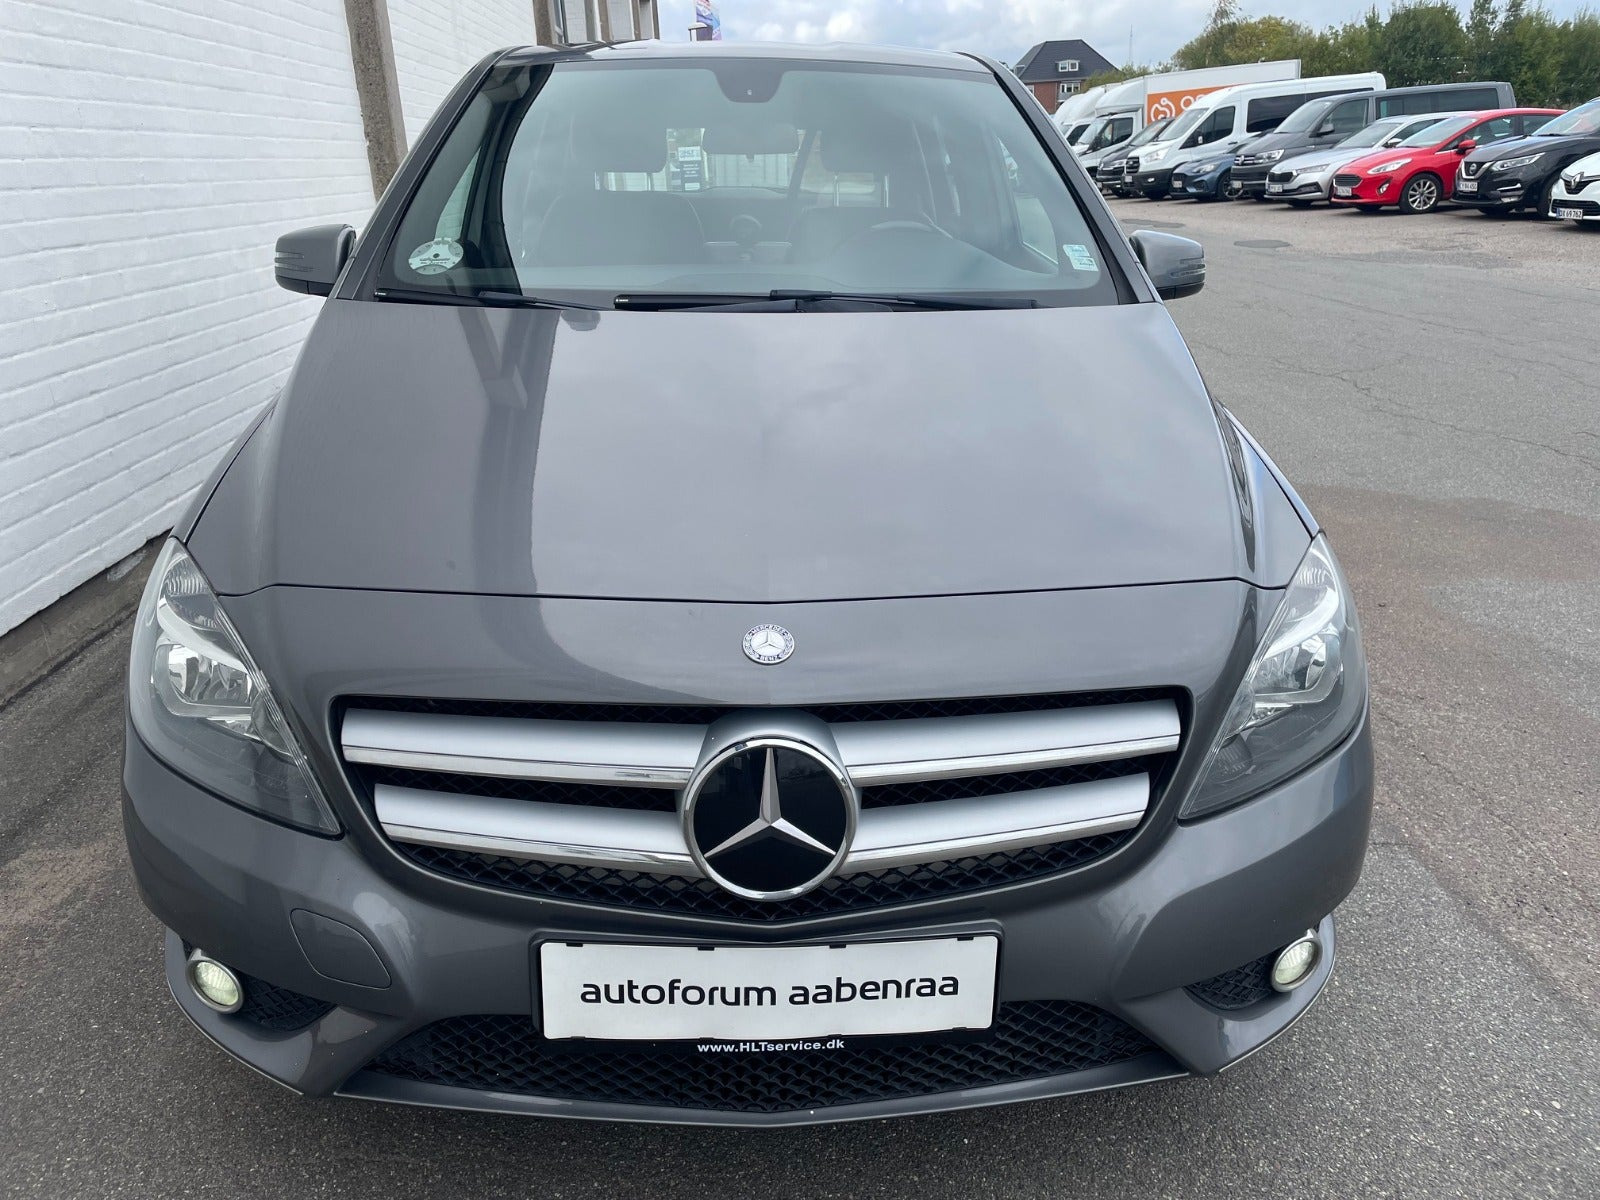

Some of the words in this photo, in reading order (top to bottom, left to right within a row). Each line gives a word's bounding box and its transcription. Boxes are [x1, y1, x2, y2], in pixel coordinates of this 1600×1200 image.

[580, 978, 777, 1006] autoforum
[788, 976, 959, 1005] aabenraa
[697, 1039, 845, 1053] www.HLTservice.dk
